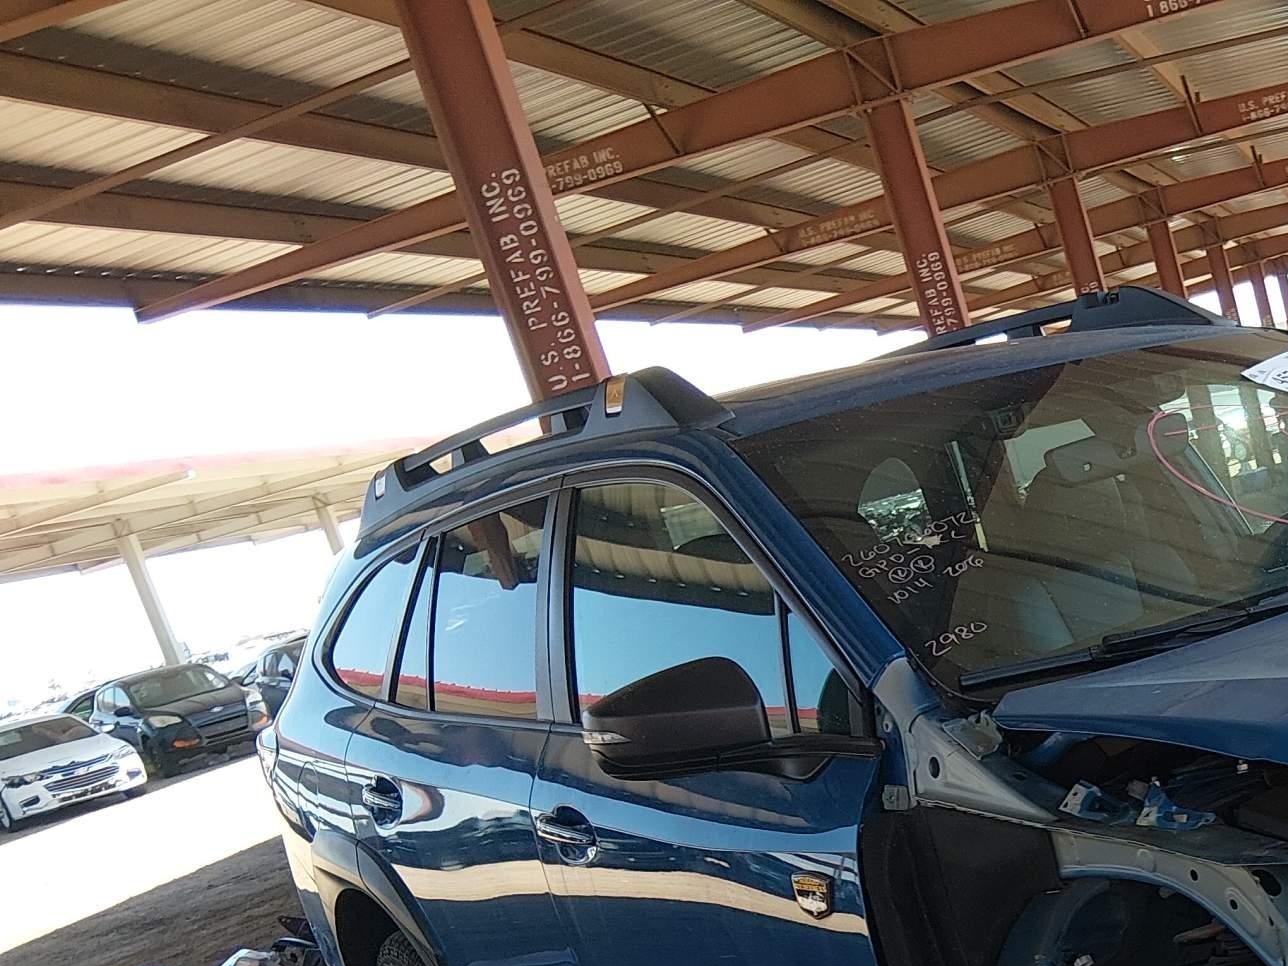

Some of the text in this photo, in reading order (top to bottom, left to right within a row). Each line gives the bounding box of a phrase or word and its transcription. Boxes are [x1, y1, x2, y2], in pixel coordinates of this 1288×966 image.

[545, 148, 621, 178] REFAB INC.
[481, 172, 569, 391] U.S. PREFAB INC.
[502, 167, 591, 383] 1-866-799-0969
[916, 253, 948, 335] REFAB INC.
[924, 621, 988, 657] 2980
